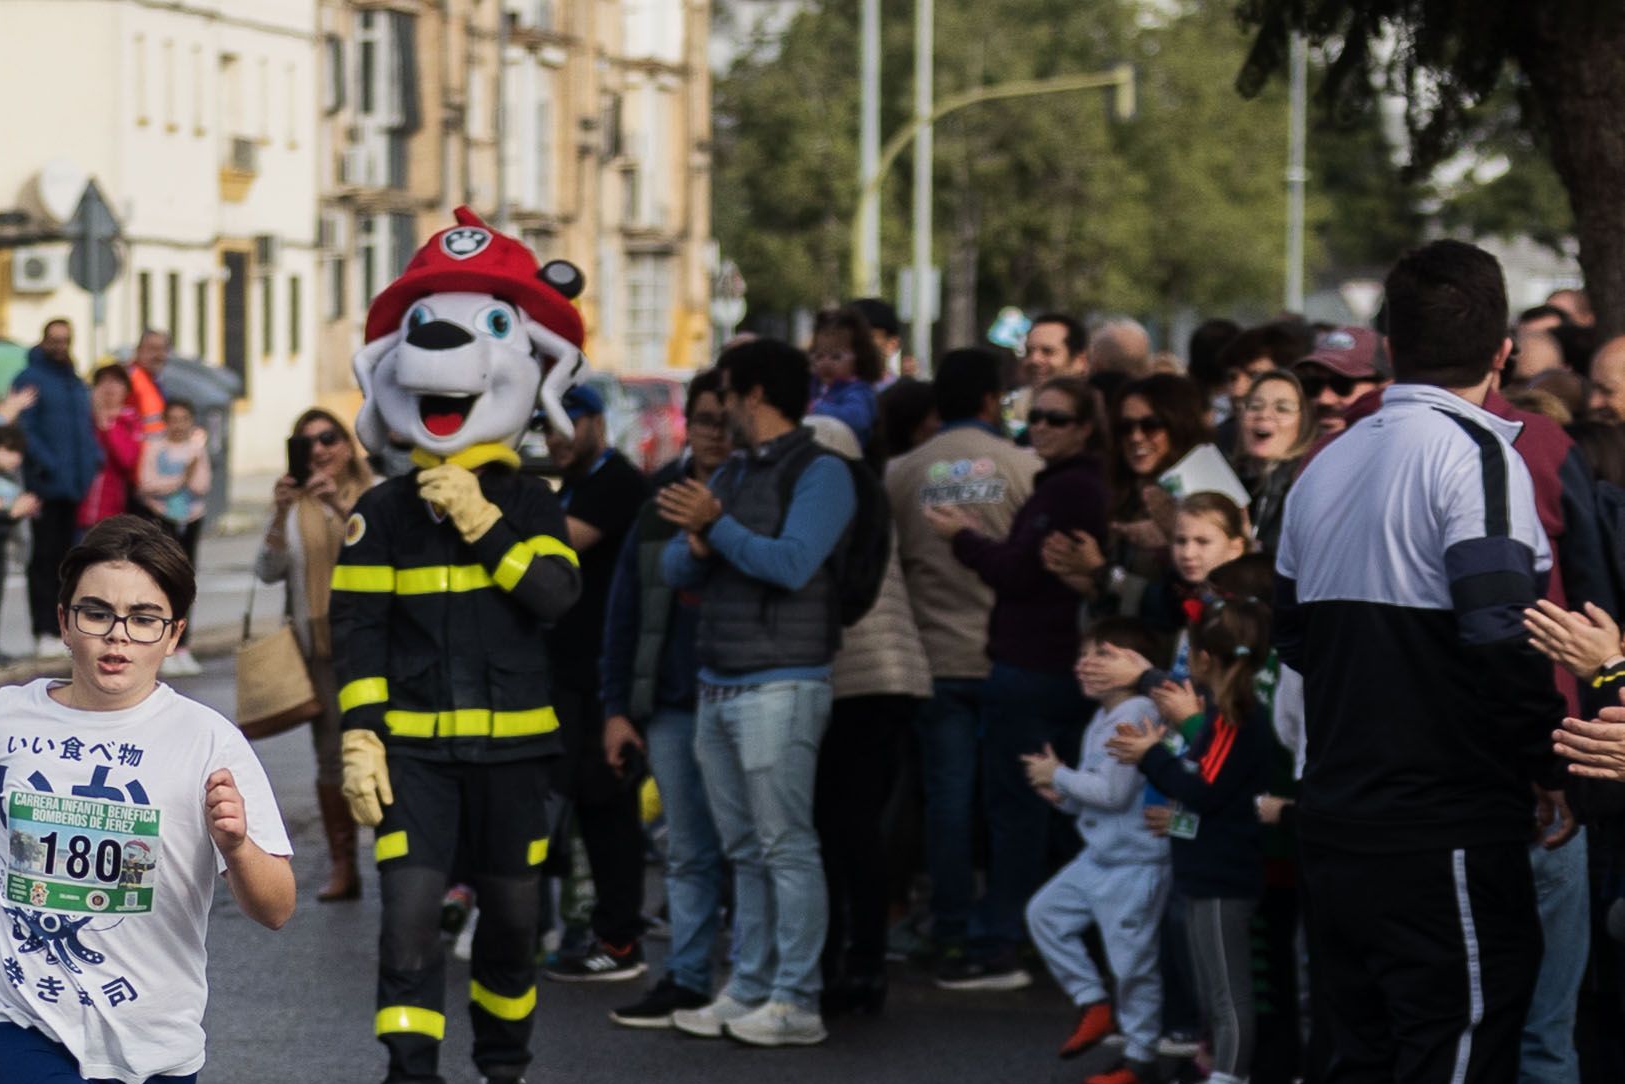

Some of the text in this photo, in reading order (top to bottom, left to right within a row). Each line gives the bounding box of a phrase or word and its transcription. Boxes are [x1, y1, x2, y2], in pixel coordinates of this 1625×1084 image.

[7, 735, 144, 767] いい食べ物
[14, 792, 157, 823] CARRERA INFANTIL BENEFICA
[32, 808, 135, 834] BOMBEROS DE JEREZ
[39, 831, 121, 883] 180
